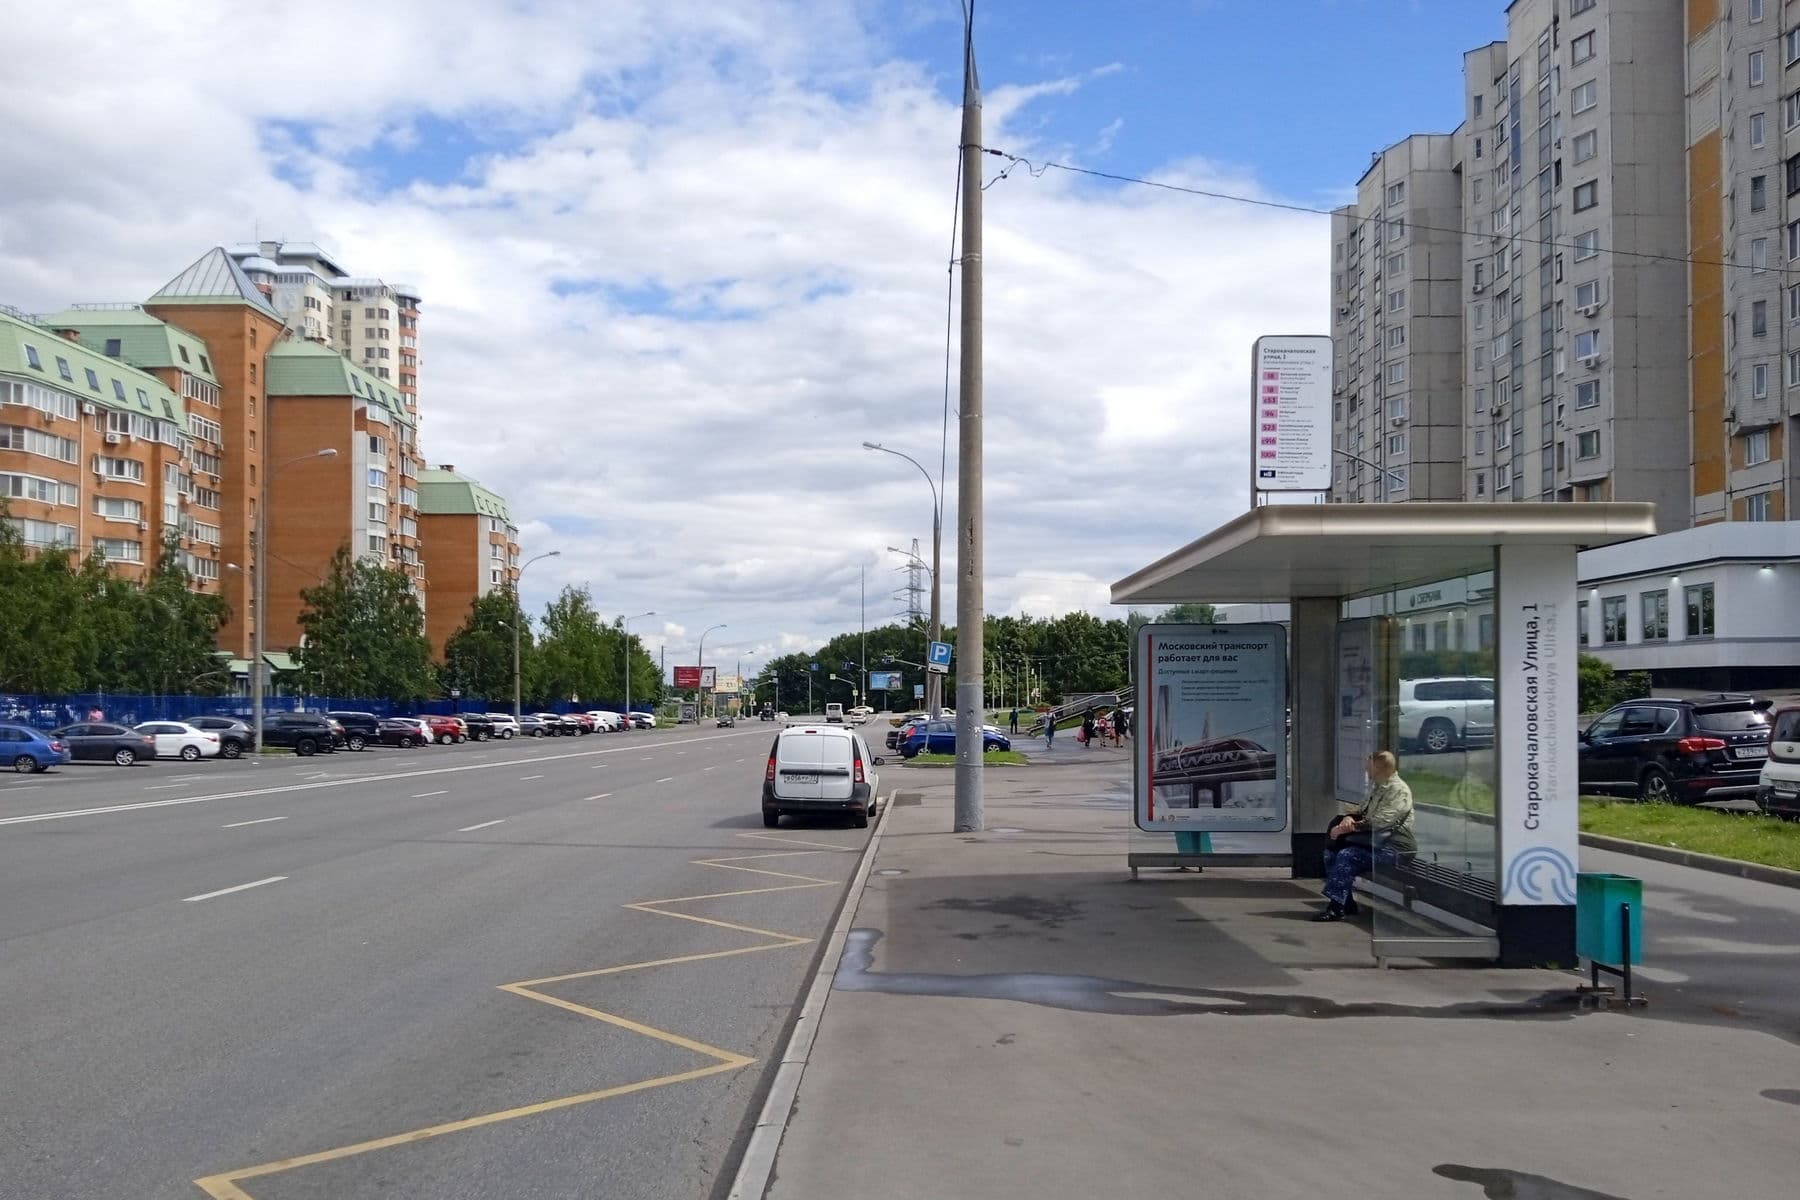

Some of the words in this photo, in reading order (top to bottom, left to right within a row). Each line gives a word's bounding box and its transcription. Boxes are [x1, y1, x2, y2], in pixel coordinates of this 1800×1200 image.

[1522, 603, 1538, 611] 1
[1158, 641, 1217, 650] Московский
[1219, 642, 1269, 652] транспорт
[1522, 615, 1541, 671] Улица,
[933, 645, 947, 660] P
[1158, 653, 1201, 663] работает
[1202, 655, 1220, 663] для
[1524, 676, 1542, 830] Старокачаловская
